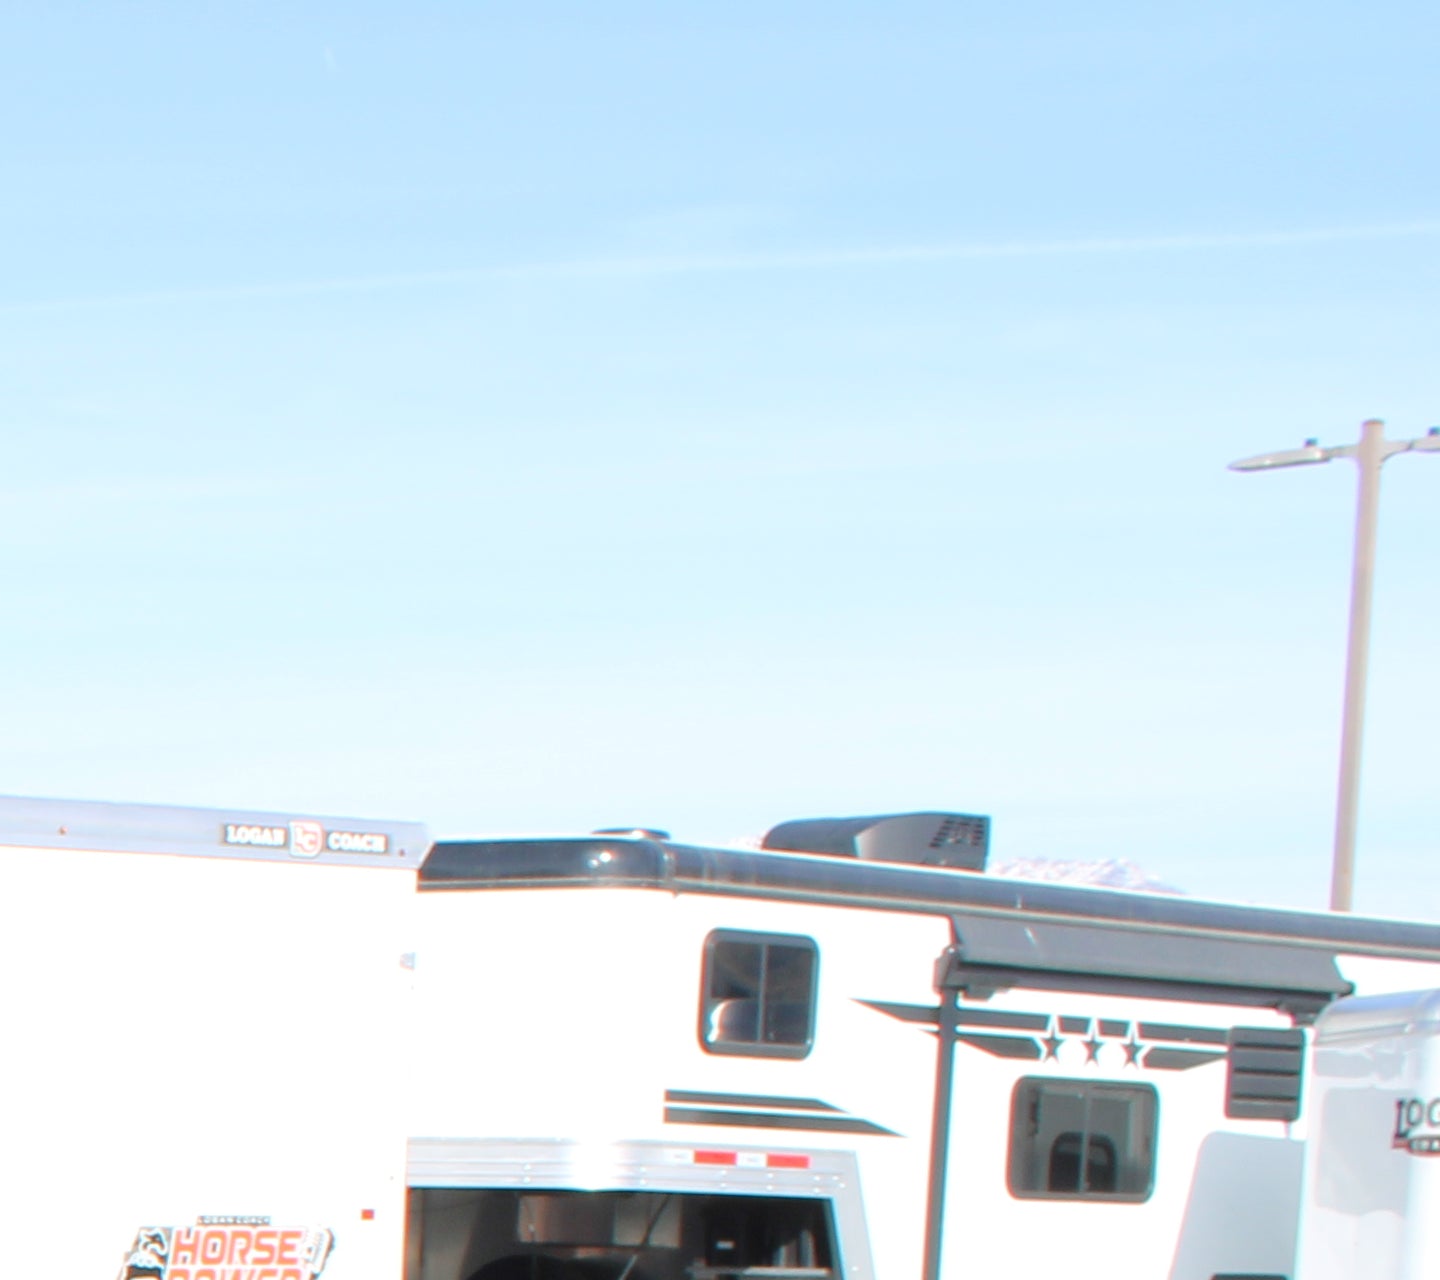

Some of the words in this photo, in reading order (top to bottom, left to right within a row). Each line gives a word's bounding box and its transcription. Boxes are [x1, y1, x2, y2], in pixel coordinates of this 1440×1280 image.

[226, 825, 285, 846] LOGAN
[328, 832, 386, 853] COACH
[172, 1230, 304, 1266] HORSE
